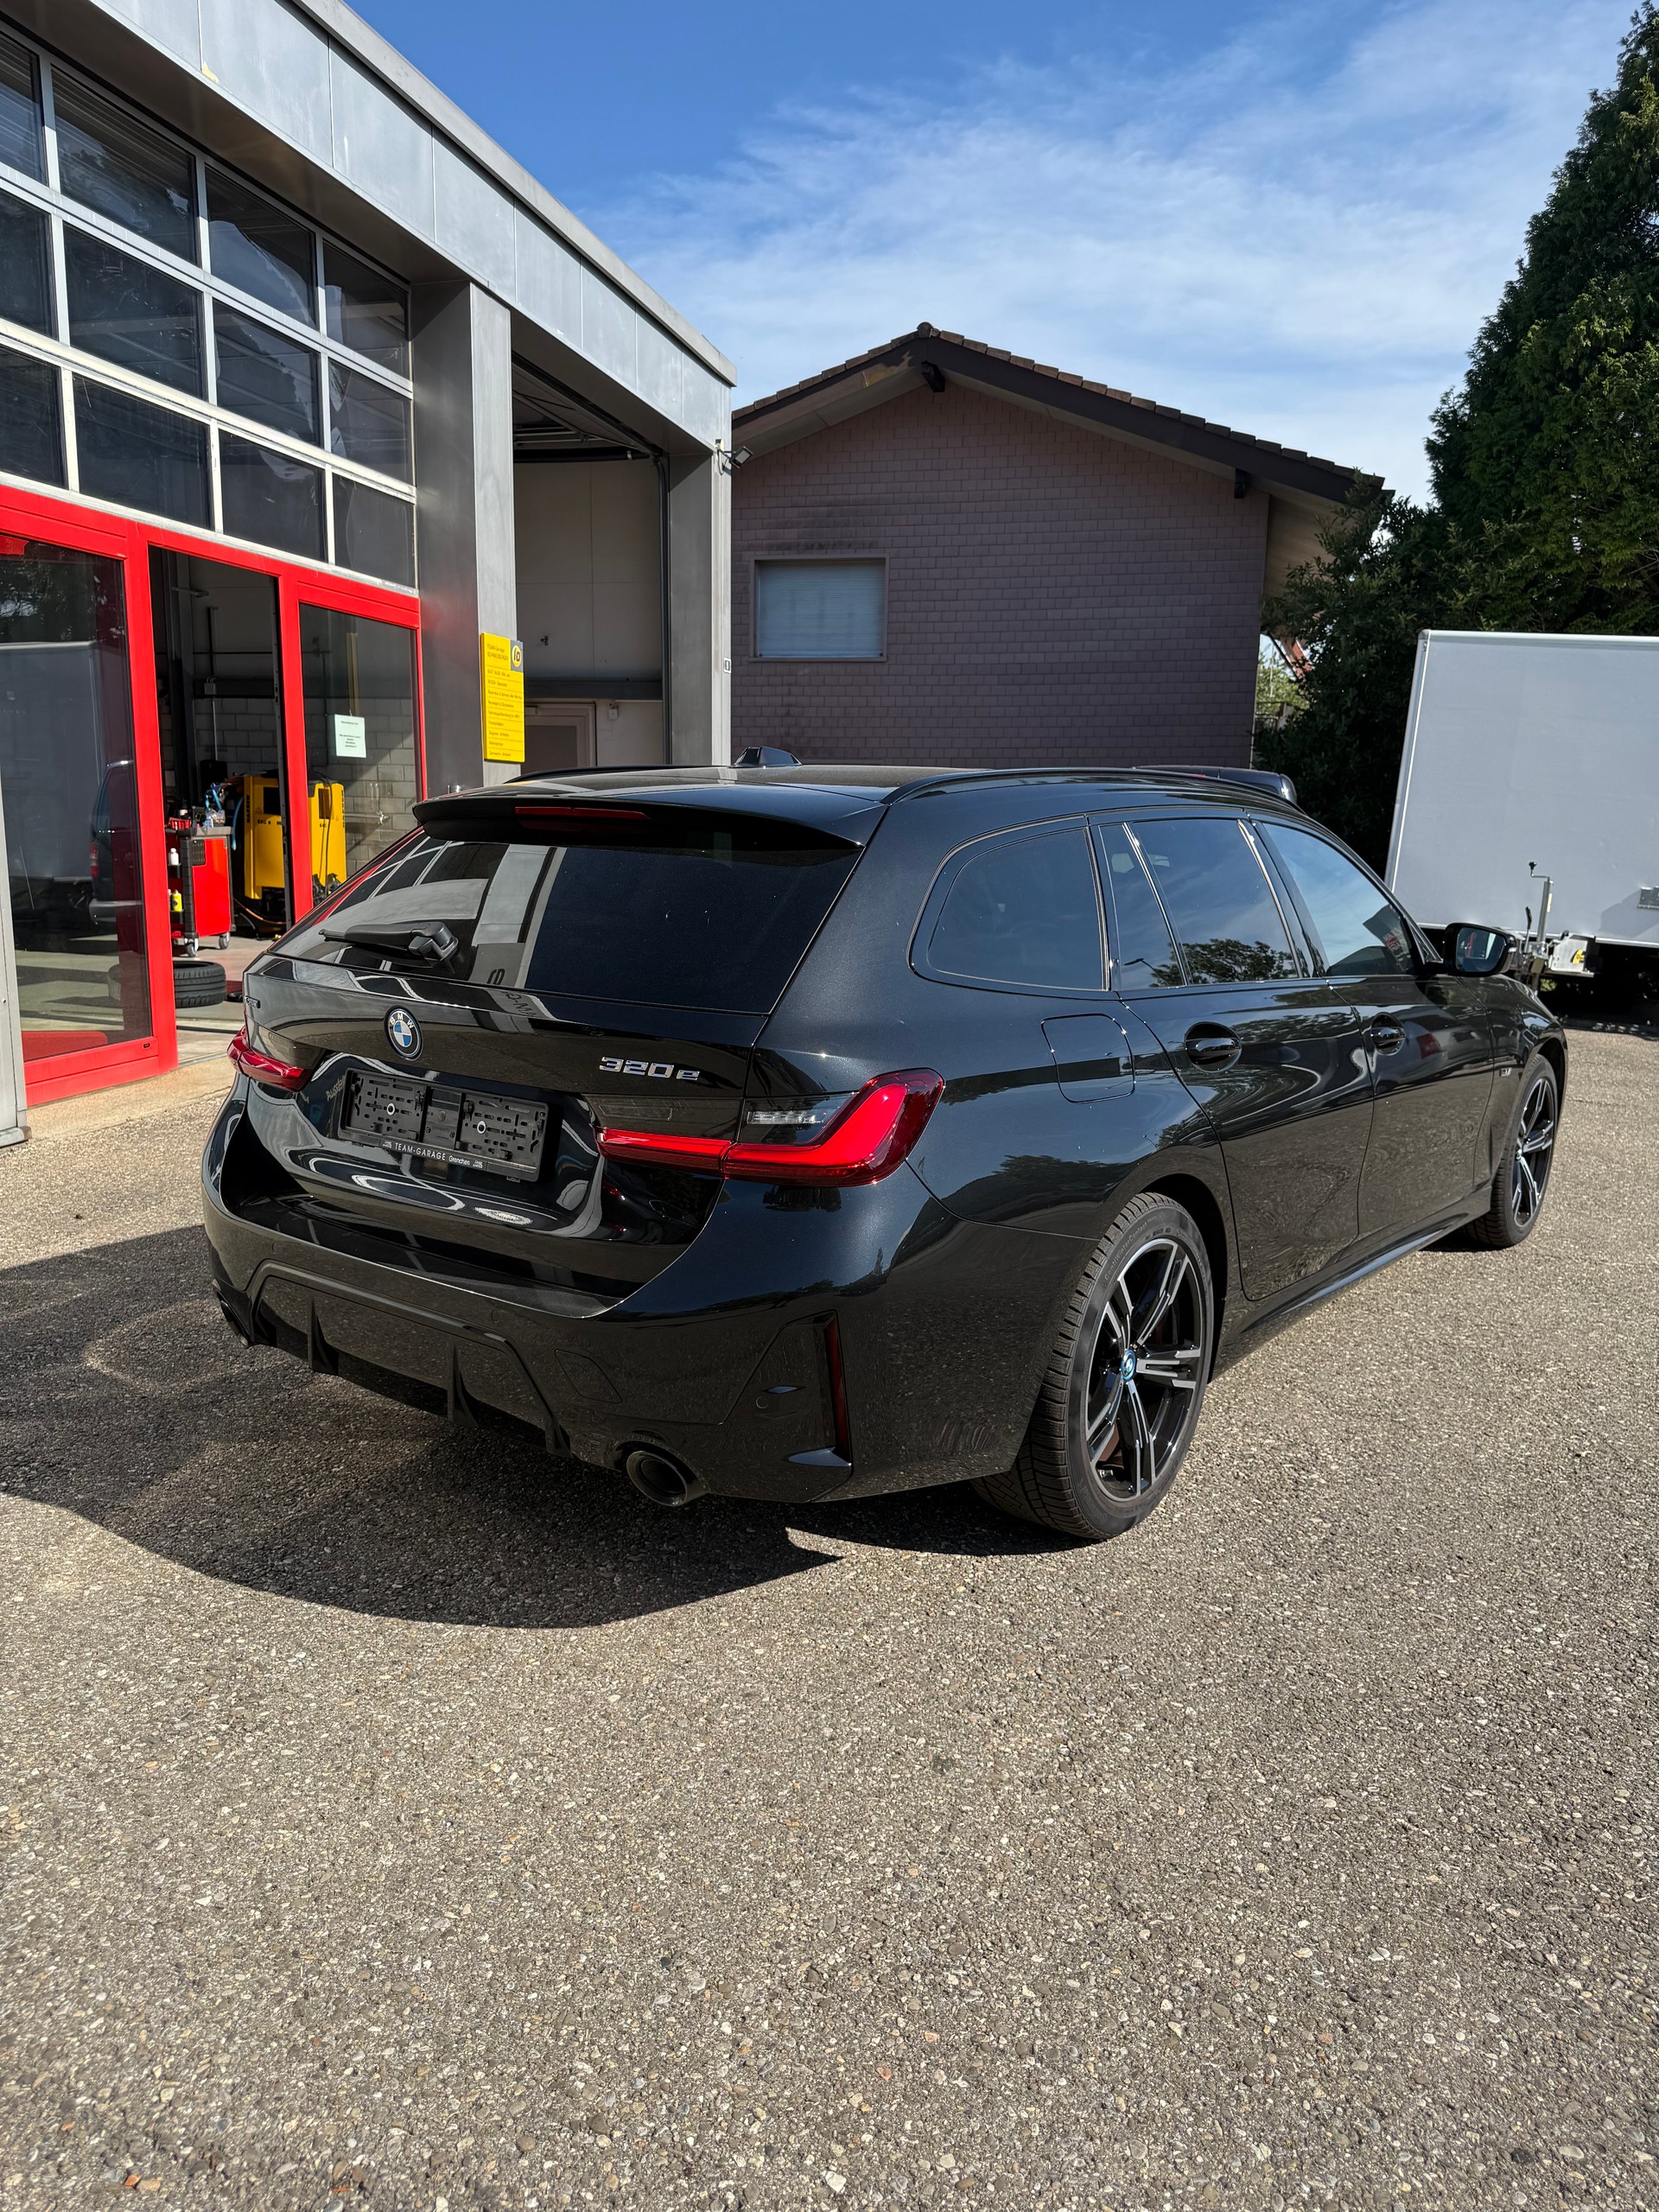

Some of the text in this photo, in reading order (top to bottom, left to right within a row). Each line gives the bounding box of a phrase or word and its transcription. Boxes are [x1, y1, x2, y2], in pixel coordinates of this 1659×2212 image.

[599, 1056, 700, 1082] 320e
[394, 1141, 447, 1160] TEAM-GARAGE
[448, 1154, 471, 1166] Grenchen
